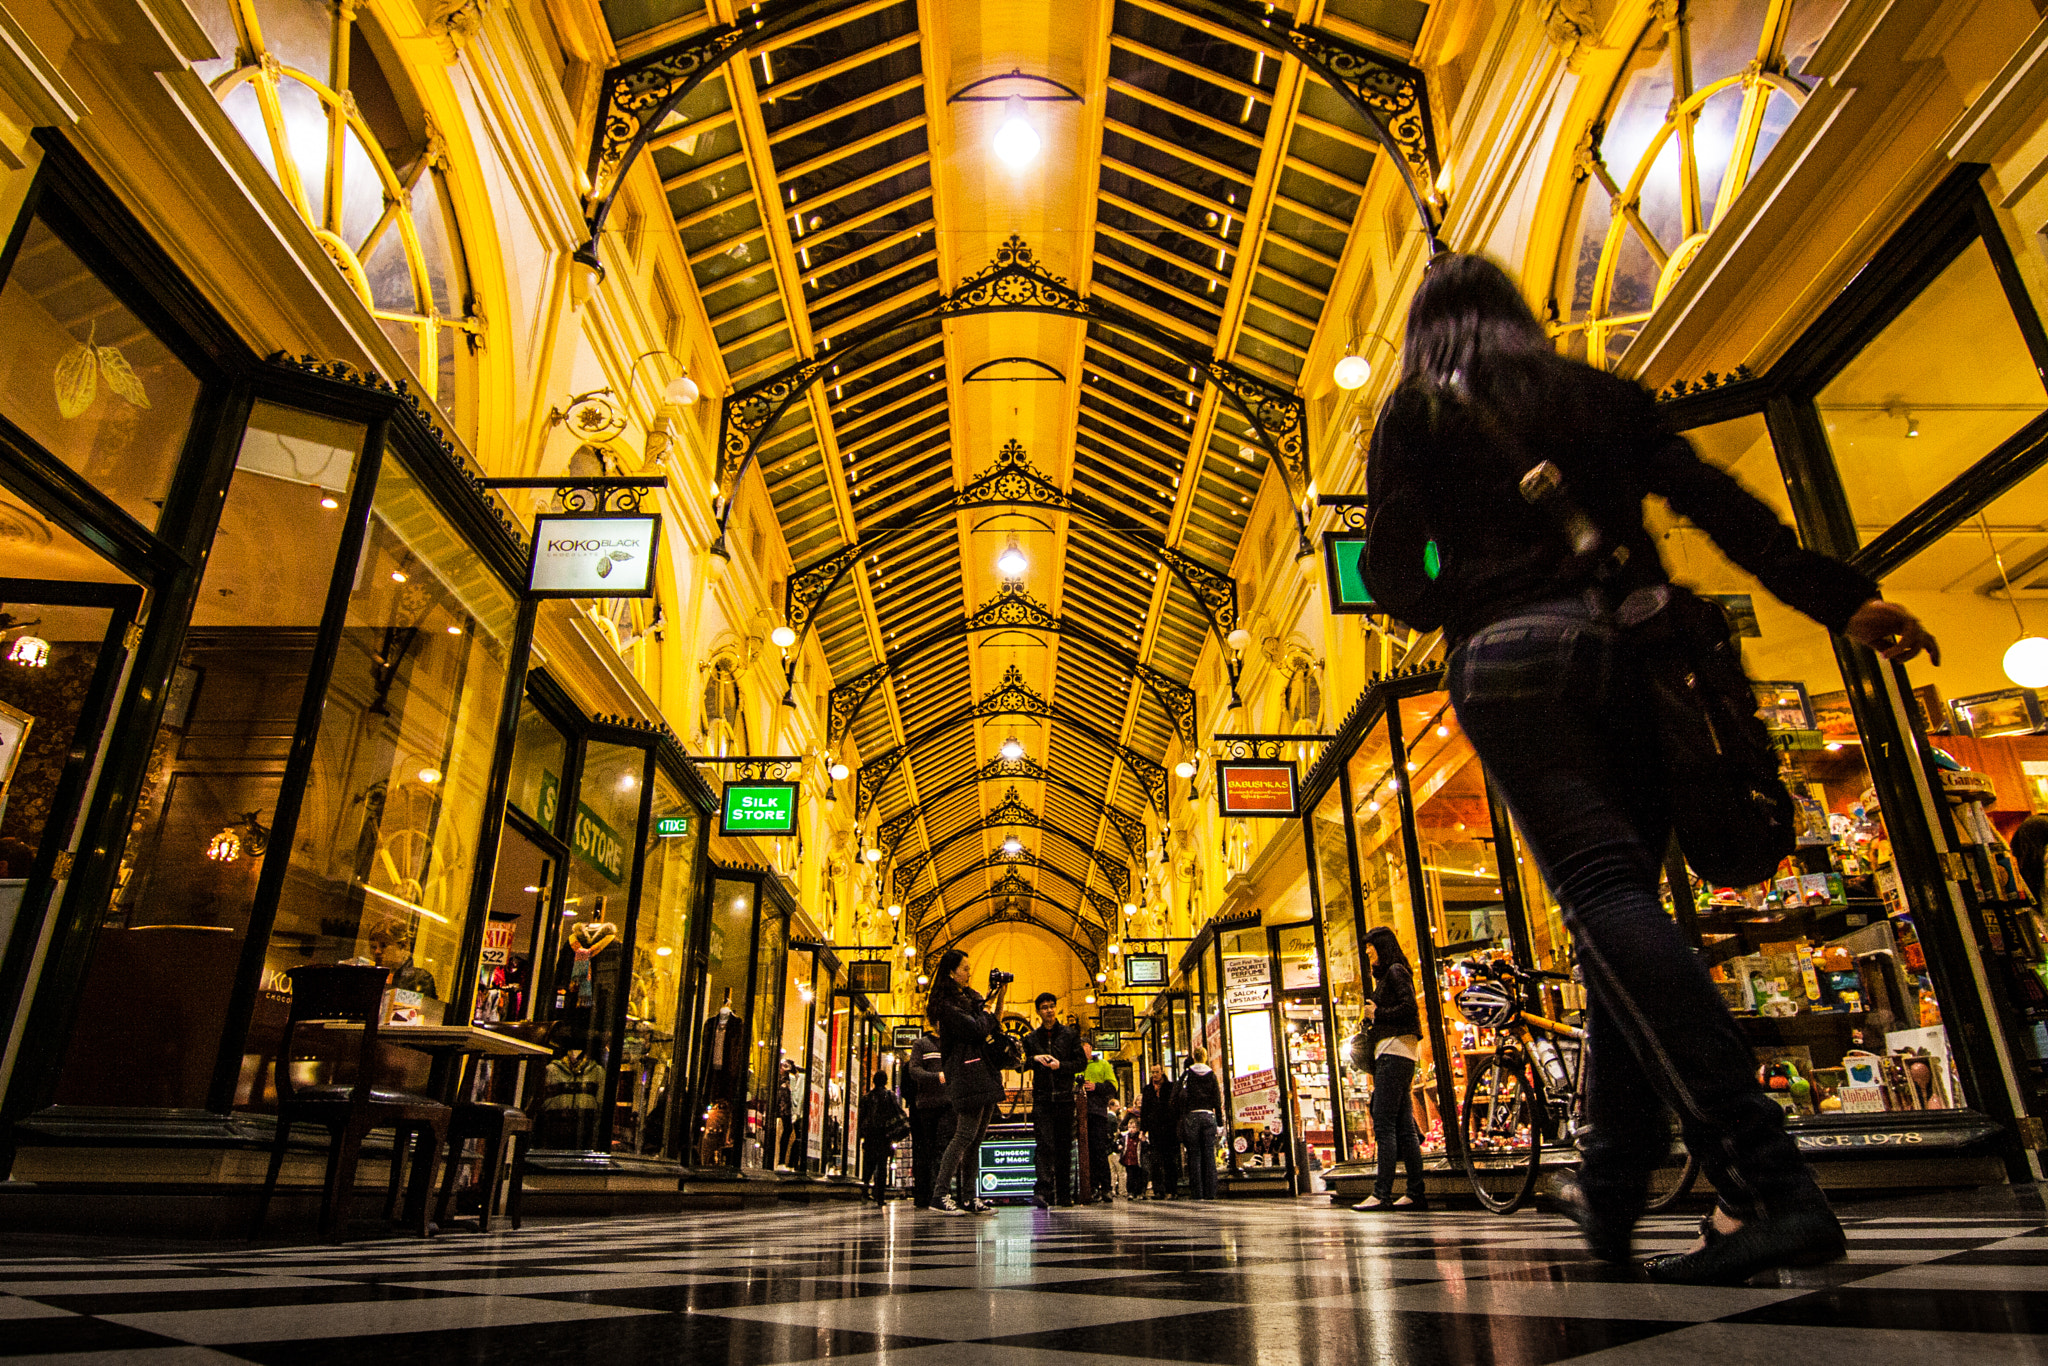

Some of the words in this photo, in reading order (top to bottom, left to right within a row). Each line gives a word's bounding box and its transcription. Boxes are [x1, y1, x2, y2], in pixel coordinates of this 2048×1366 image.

[548, 539, 600, 552] KOKO
[601, 539, 640, 547] BLACK
[1881, 742, 1889, 758] 7
[742, 796, 778, 807] SILK
[732, 808, 786, 820] STORE
[581, 818, 623, 876] STORE
[1226, 963, 1267, 972] FAVOURITE
[1231, 969, 1264, 978] PERFUME
[1229, 995, 1261, 1004] UPSTAIRS
[1842, 1089, 1881, 1104] Alphabet
[1239, 1109, 1275, 1117] JEWELLERY
[1863, 1132, 1923, 1146] 1978
[994, 1149, 1030, 1157] DUNGEON
